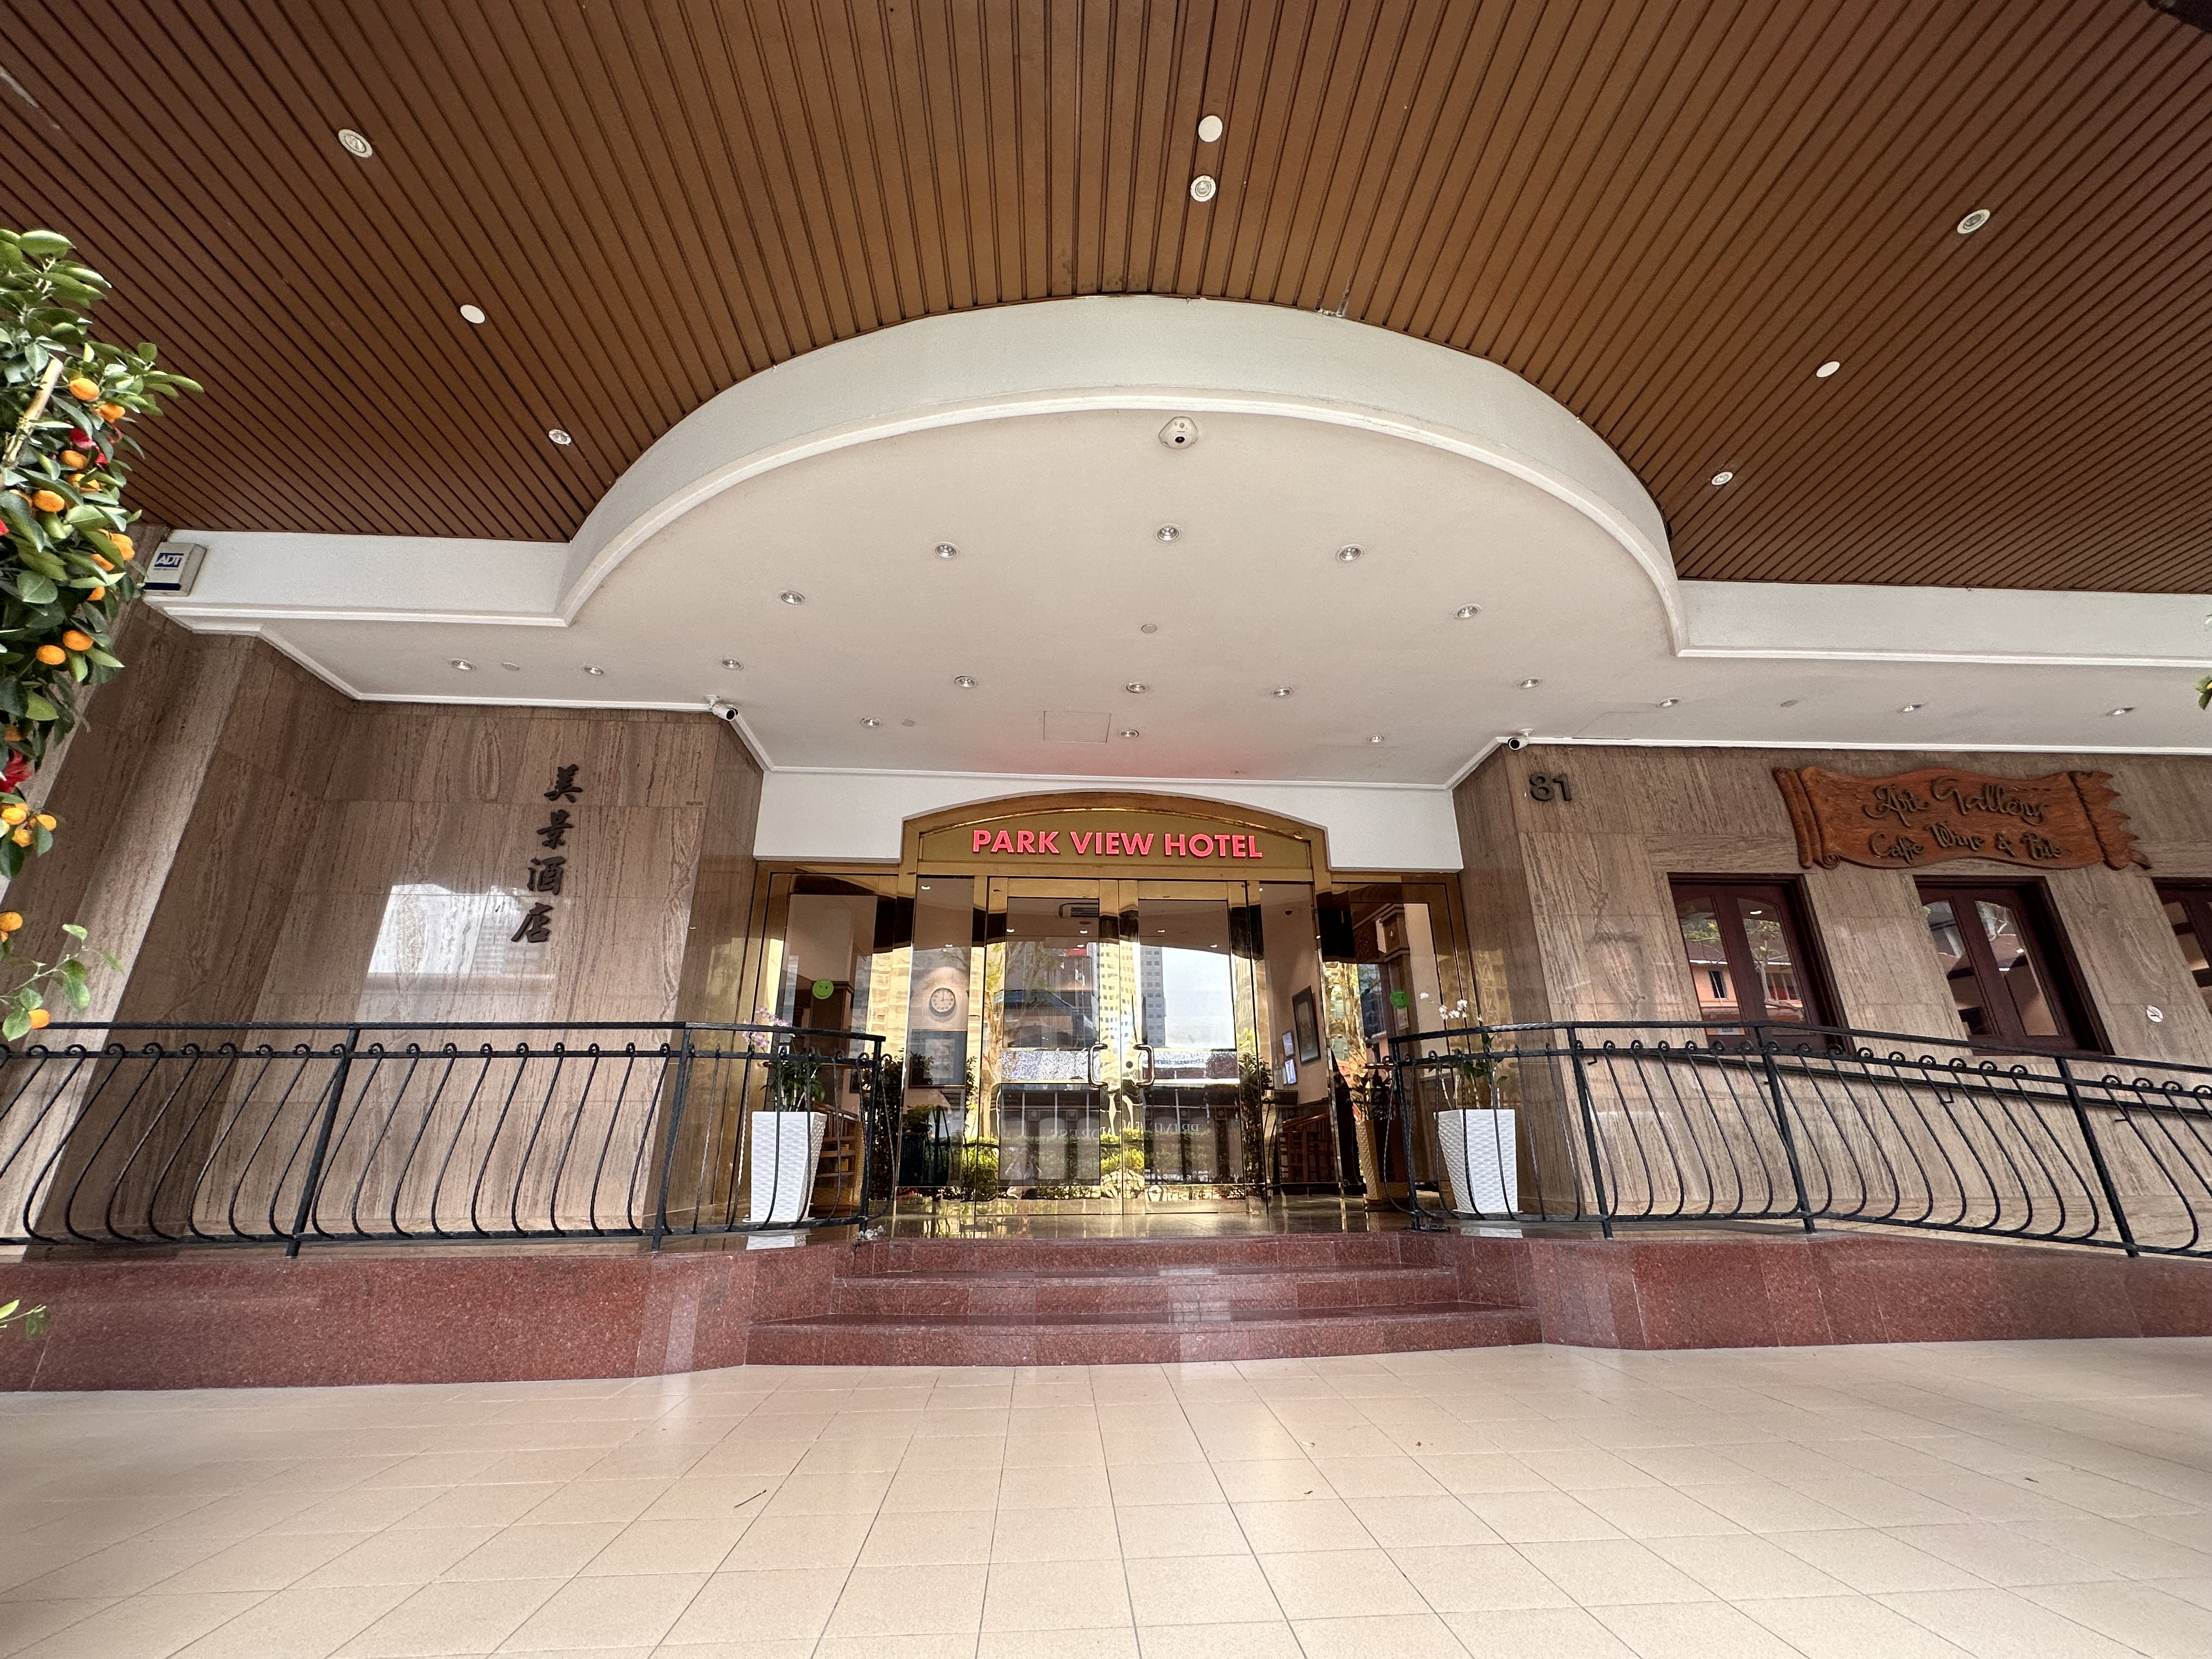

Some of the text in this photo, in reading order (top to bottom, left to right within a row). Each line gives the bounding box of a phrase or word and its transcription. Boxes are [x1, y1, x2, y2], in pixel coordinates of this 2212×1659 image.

[156, 554, 183, 565] ADT
[1529, 772, 1572, 802] 81
[1861, 776, 2049, 827] Art Gallery
[511, 763, 583, 943] 美景酒店
[973, 829, 1263, 859] PARK VIEW HOTEL
[1922, 821, 1985, 852] Wine
[1994, 832, 2016, 858] &
[2019, 831, 2063, 861] Pub
